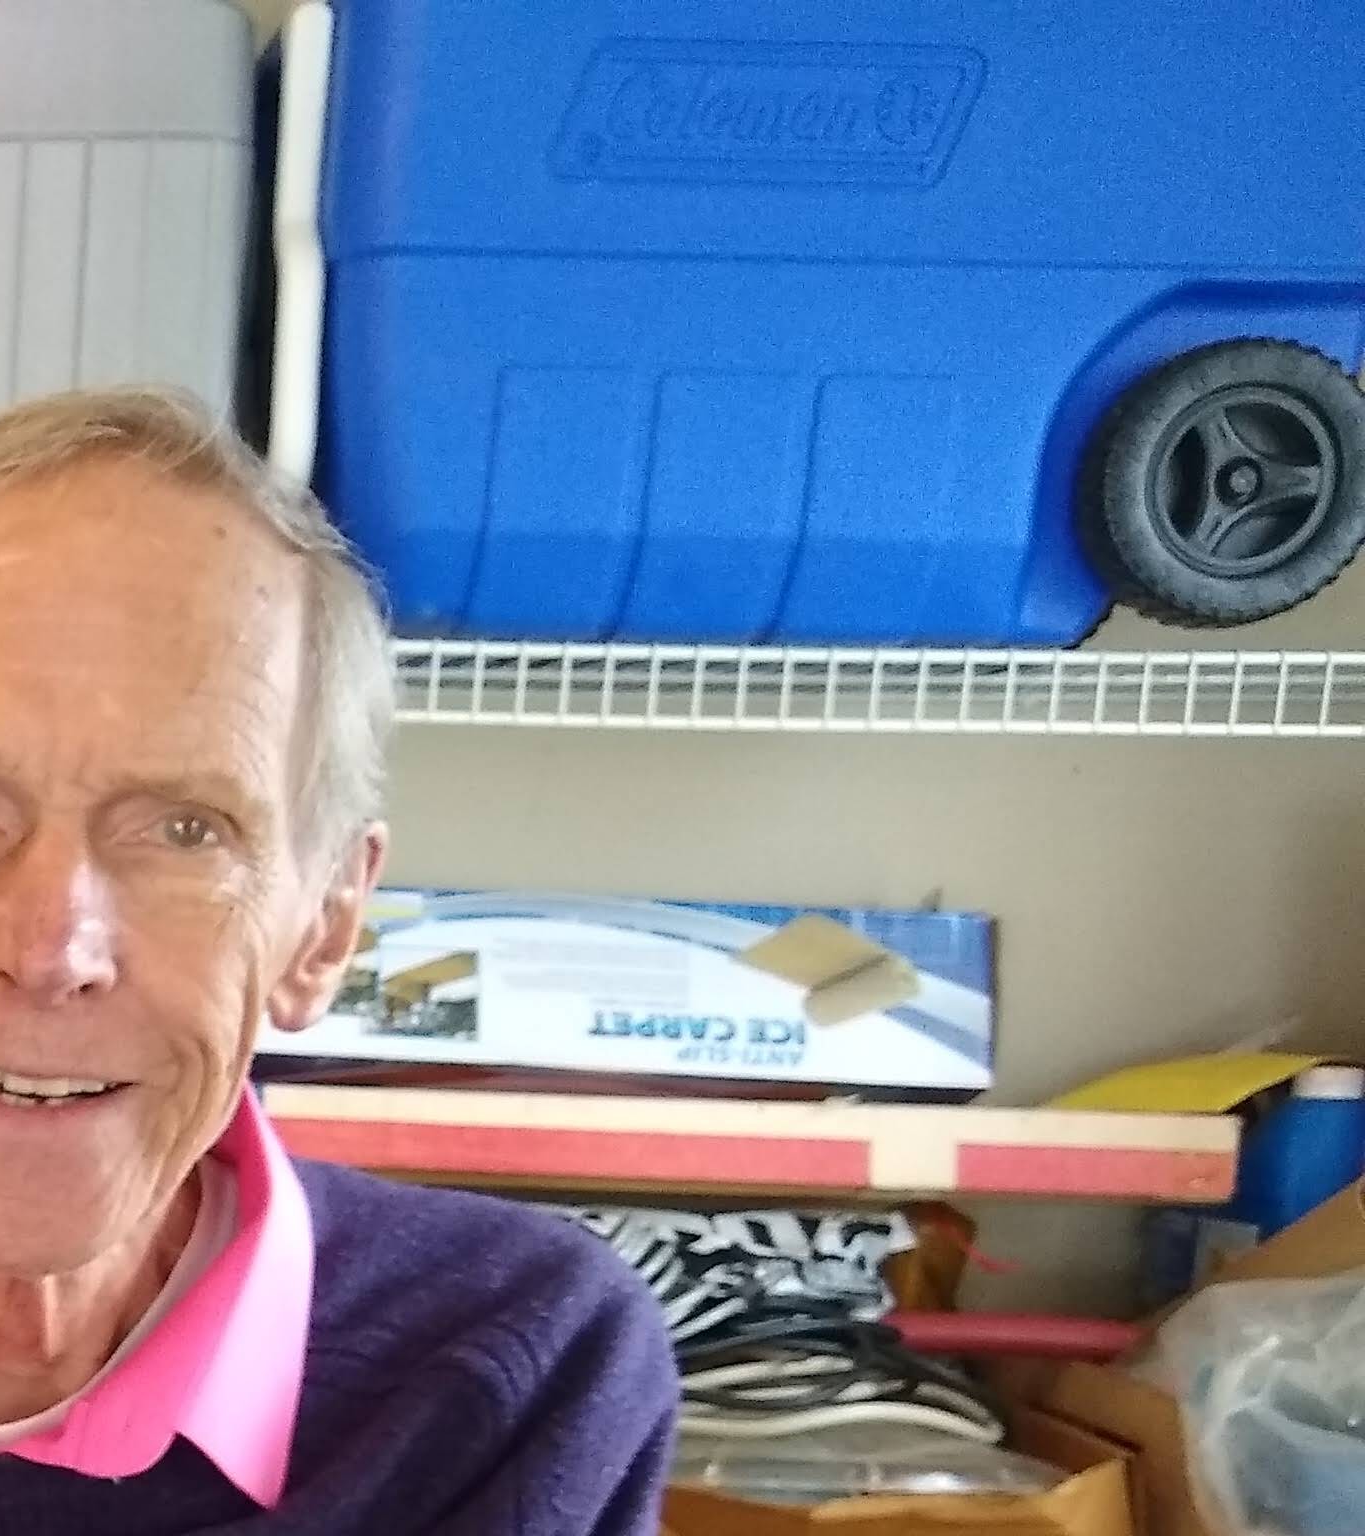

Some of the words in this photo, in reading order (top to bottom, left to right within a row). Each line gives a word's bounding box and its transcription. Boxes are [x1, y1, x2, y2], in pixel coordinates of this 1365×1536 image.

[605, 64, 862, 144] Coleman
[588, 1010, 736, 1040] CARPET
[748, 1017, 805, 1045] ICE
